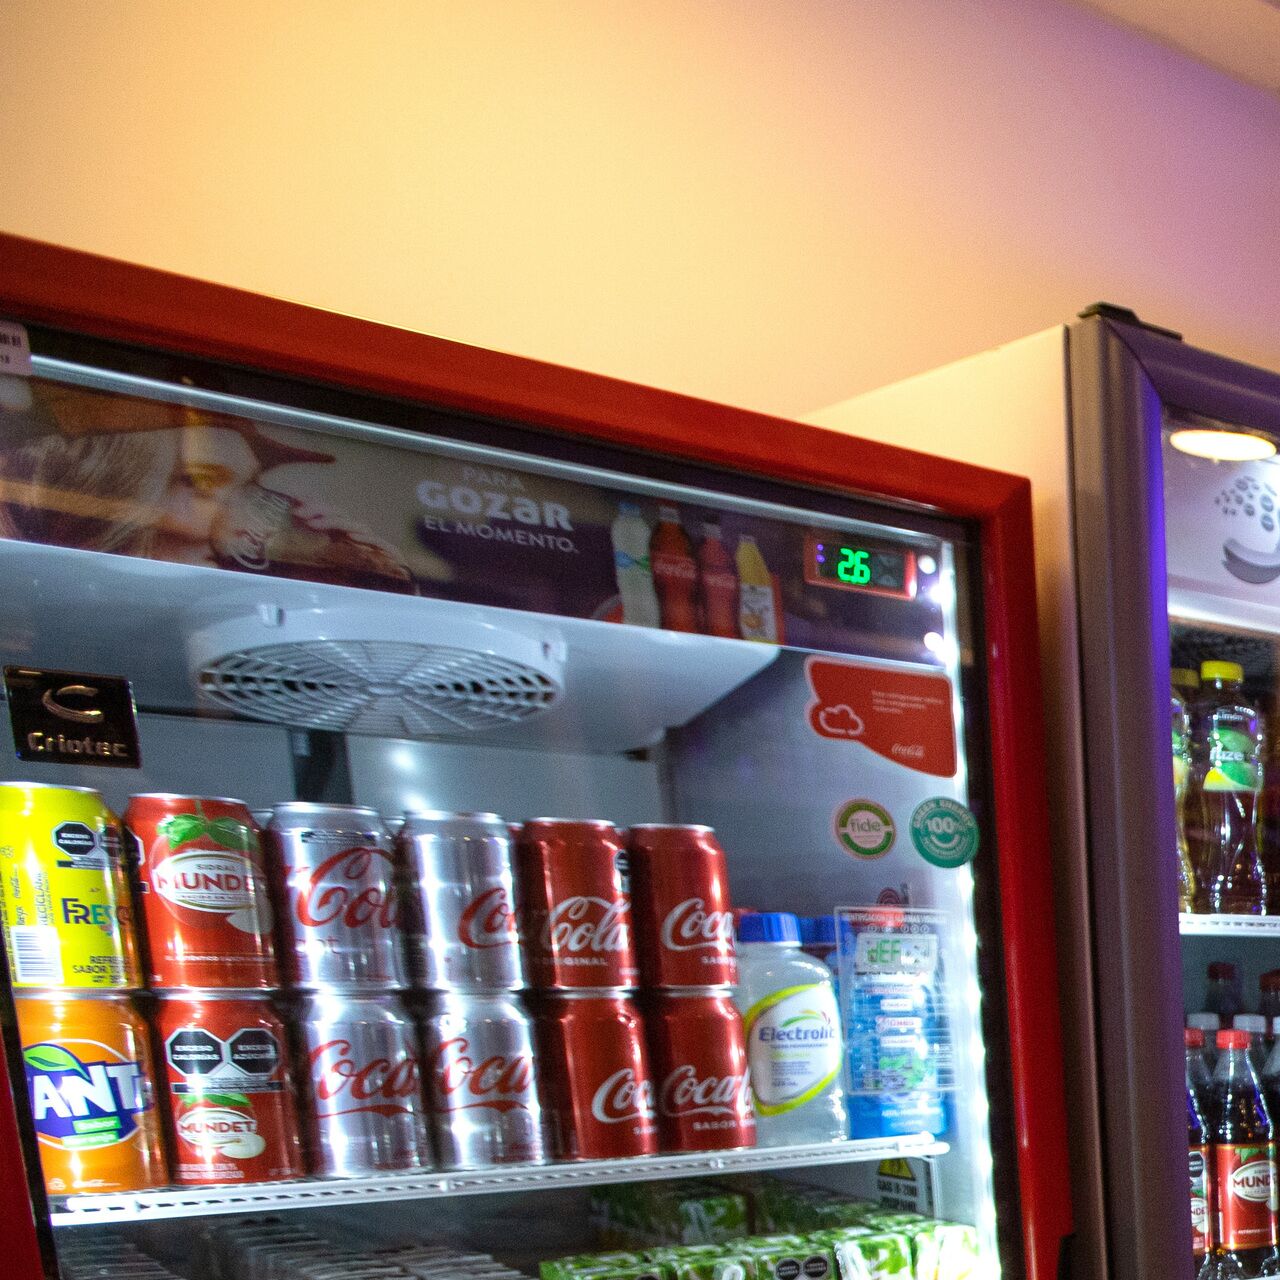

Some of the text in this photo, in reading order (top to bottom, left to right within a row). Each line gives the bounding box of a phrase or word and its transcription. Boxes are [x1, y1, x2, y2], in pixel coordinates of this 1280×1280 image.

[424, 514, 451, 533] EL
[27, 731, 129, 758] Criotec
[759, 1026, 835, 1042] Electrolit
